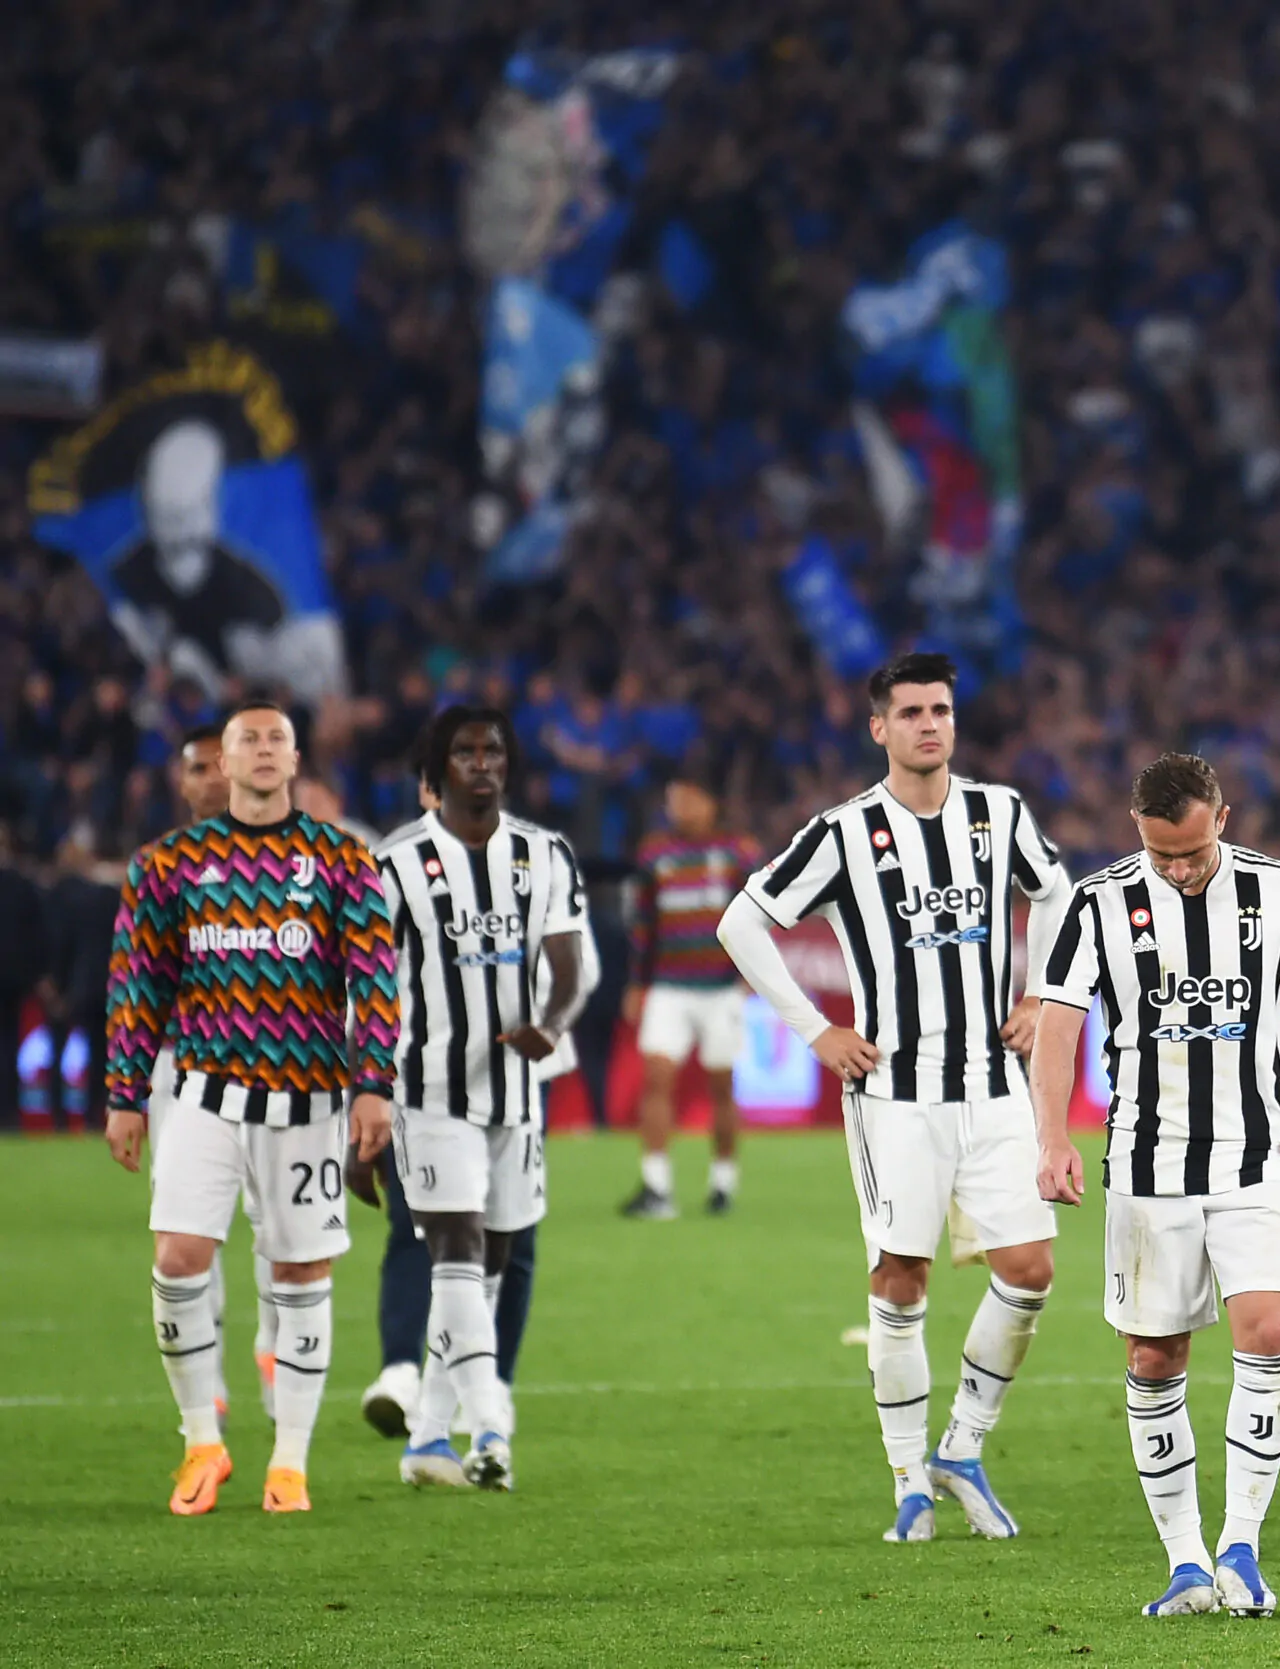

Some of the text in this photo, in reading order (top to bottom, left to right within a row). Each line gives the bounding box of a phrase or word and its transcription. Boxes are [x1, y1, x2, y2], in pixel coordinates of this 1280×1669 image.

[897, 884, 985, 918] Jeep
[188, 922, 273, 953] Allianz
[445, 908, 523, 941] Jeep
[1130, 943, 1160, 953] adidas
[1149, 970, 1251, 1011] Jeep
[290, 1158, 343, 1205] 20
